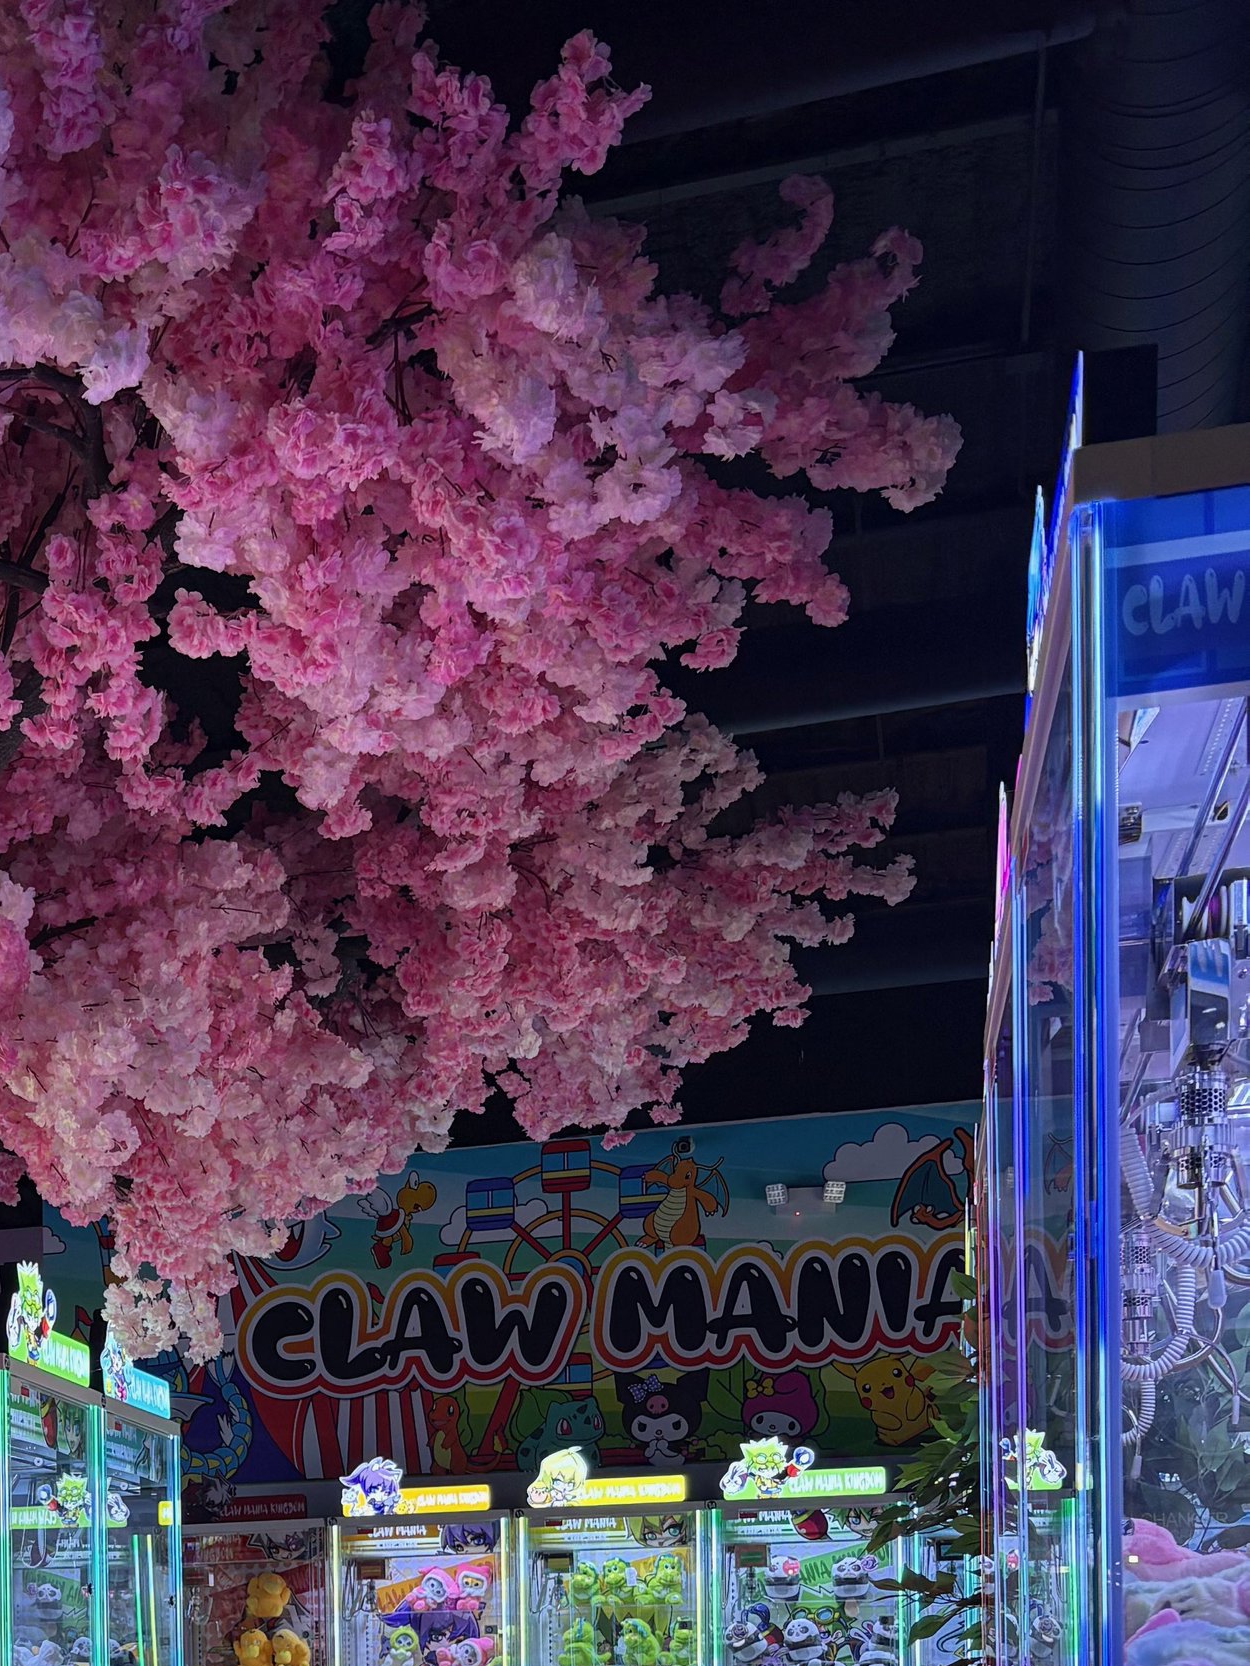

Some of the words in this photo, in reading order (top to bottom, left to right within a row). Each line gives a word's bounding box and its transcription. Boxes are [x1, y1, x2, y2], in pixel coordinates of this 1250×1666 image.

[1122, 567, 1245, 636] CLAW
[246, 1270, 580, 1389] CLAW
[244, 1503, 269, 1516] MANIA
[270, 1502, 306, 1515] KINGDOM
[798, 1564, 831, 1586] ANIA
